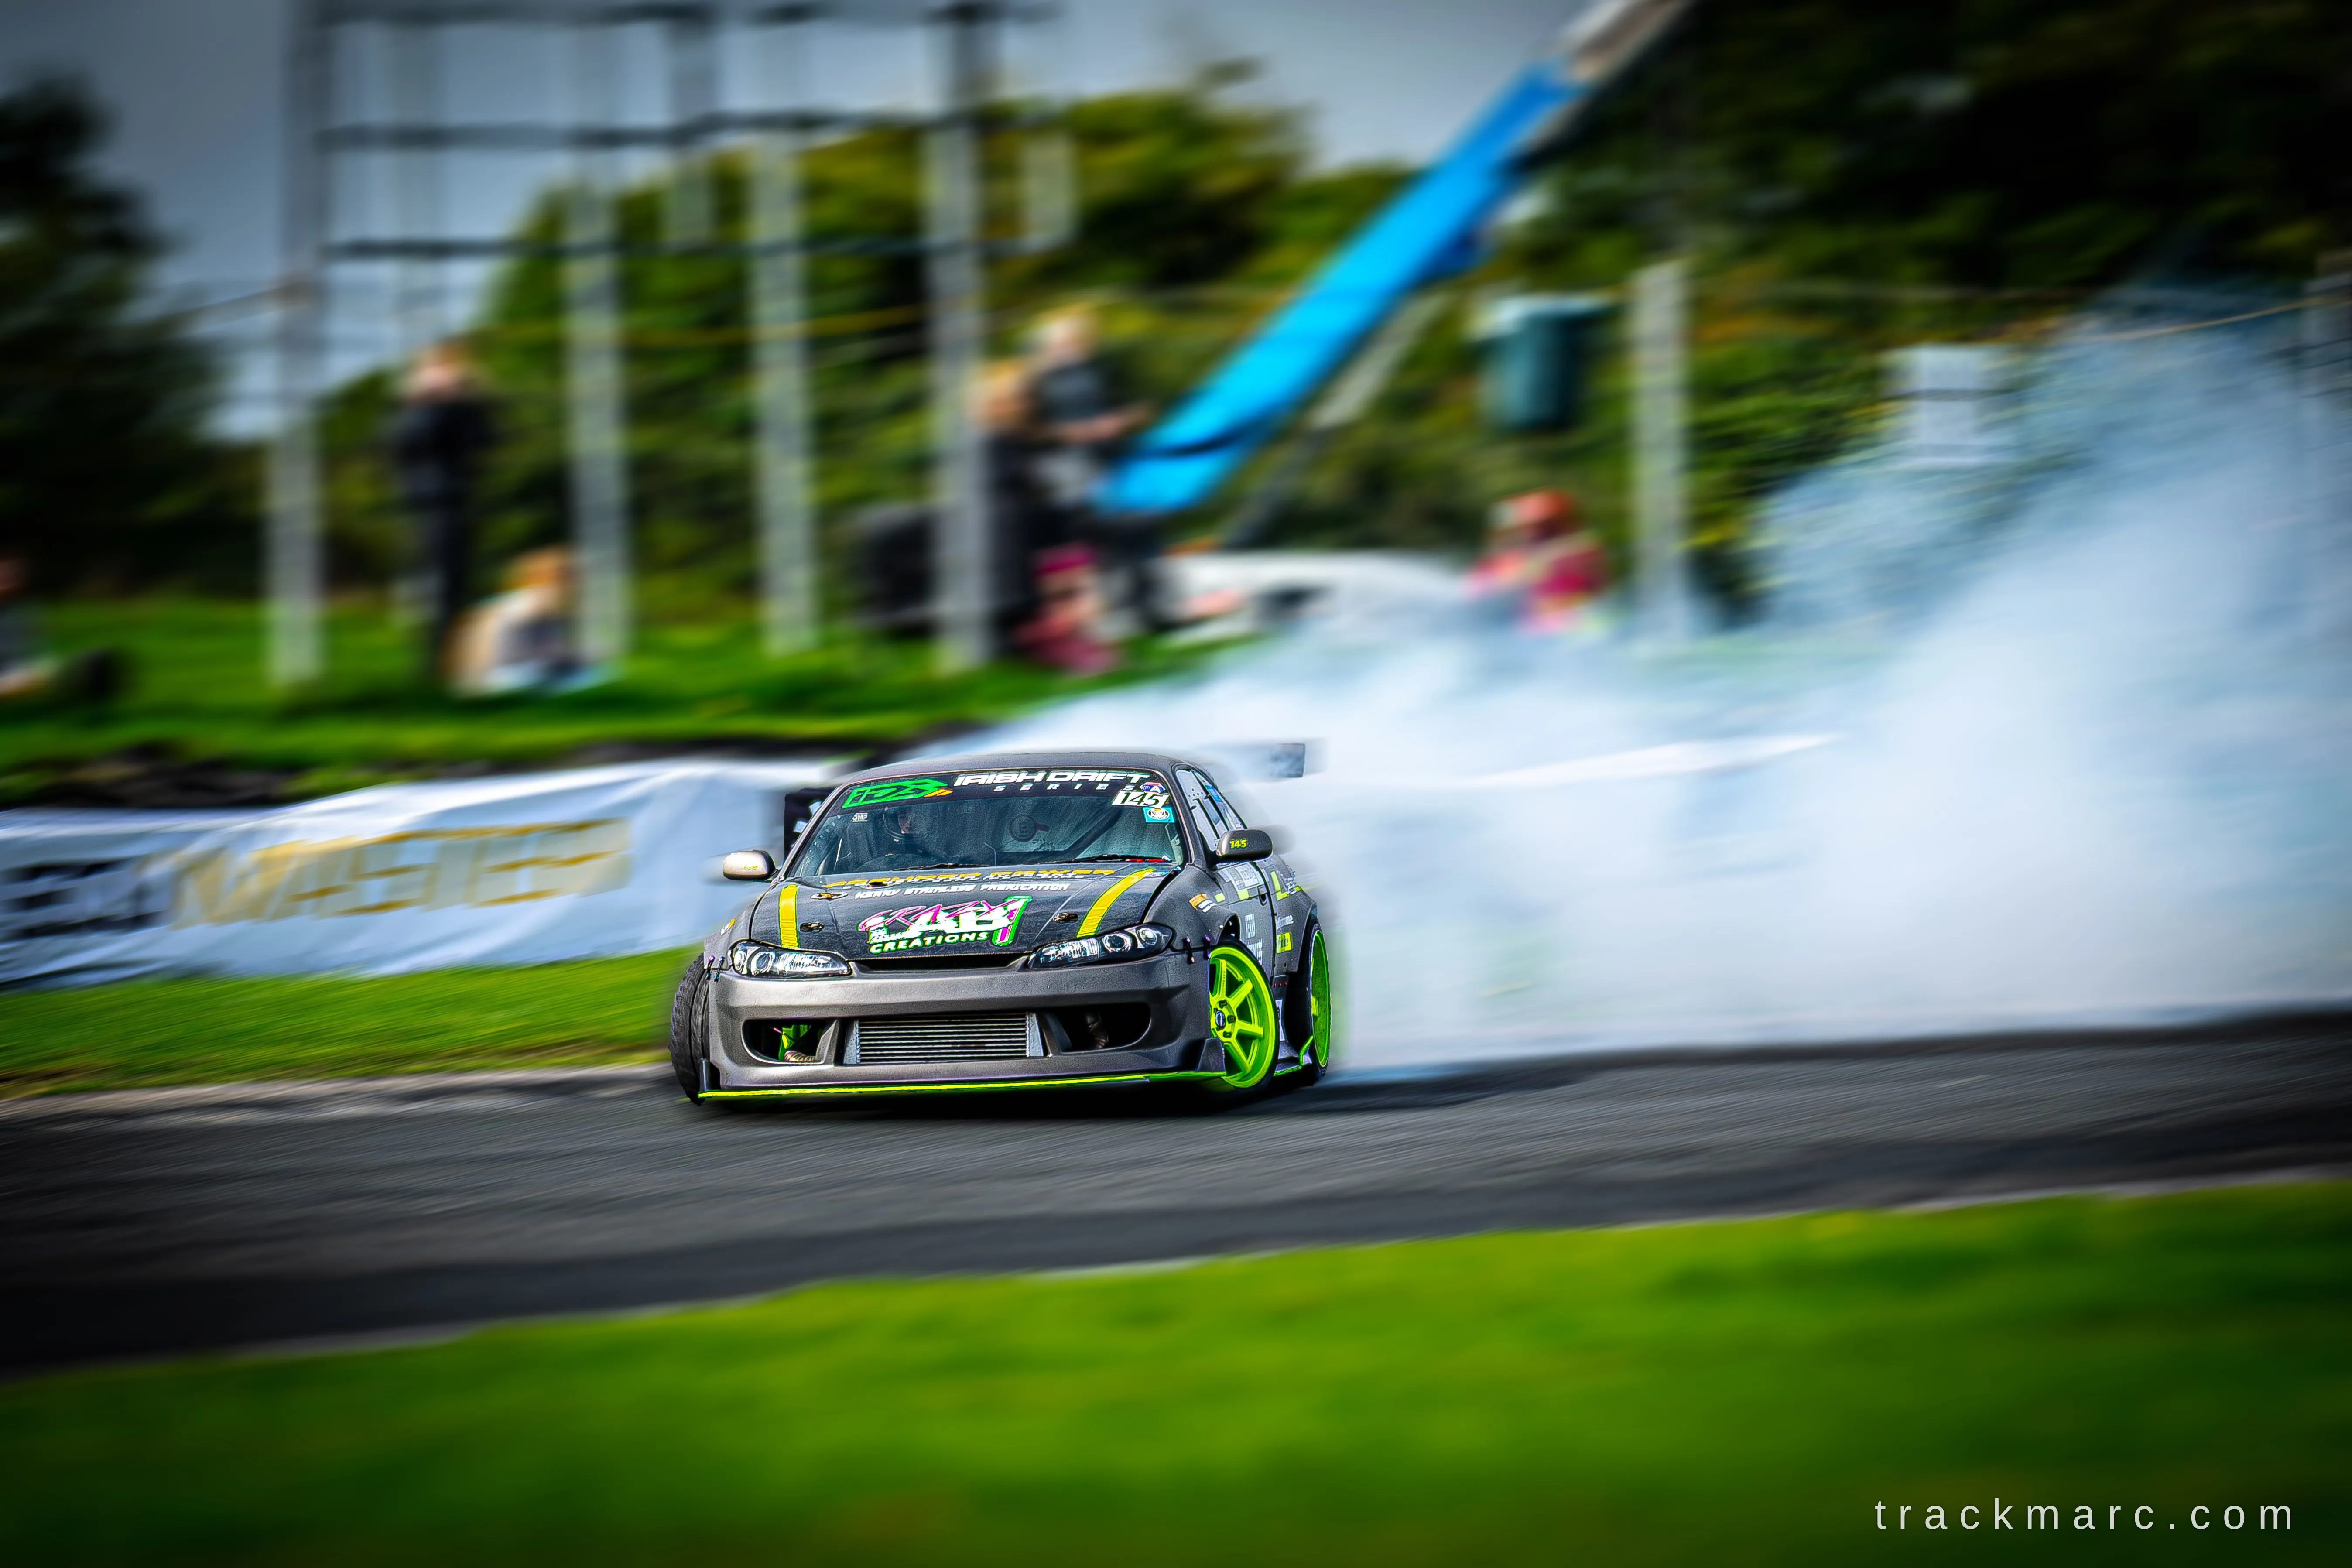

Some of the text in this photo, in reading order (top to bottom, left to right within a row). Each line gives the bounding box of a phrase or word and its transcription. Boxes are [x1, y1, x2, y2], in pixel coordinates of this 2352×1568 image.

[954, 771, 1150, 786] IRISH DRIFT
[993, 783, 1135, 792] SERIES
[1120, 792, 1163, 806] 145
[852, 813, 868, 822] OMP
[1230, 839, 1247, 849] 145
[855, 889, 902, 899] KERRY
[980, 883, 1070, 891] FABRICATION
[857, 899, 1019, 931] CRAZY
[870, 932, 989, 954] CREATIONS
